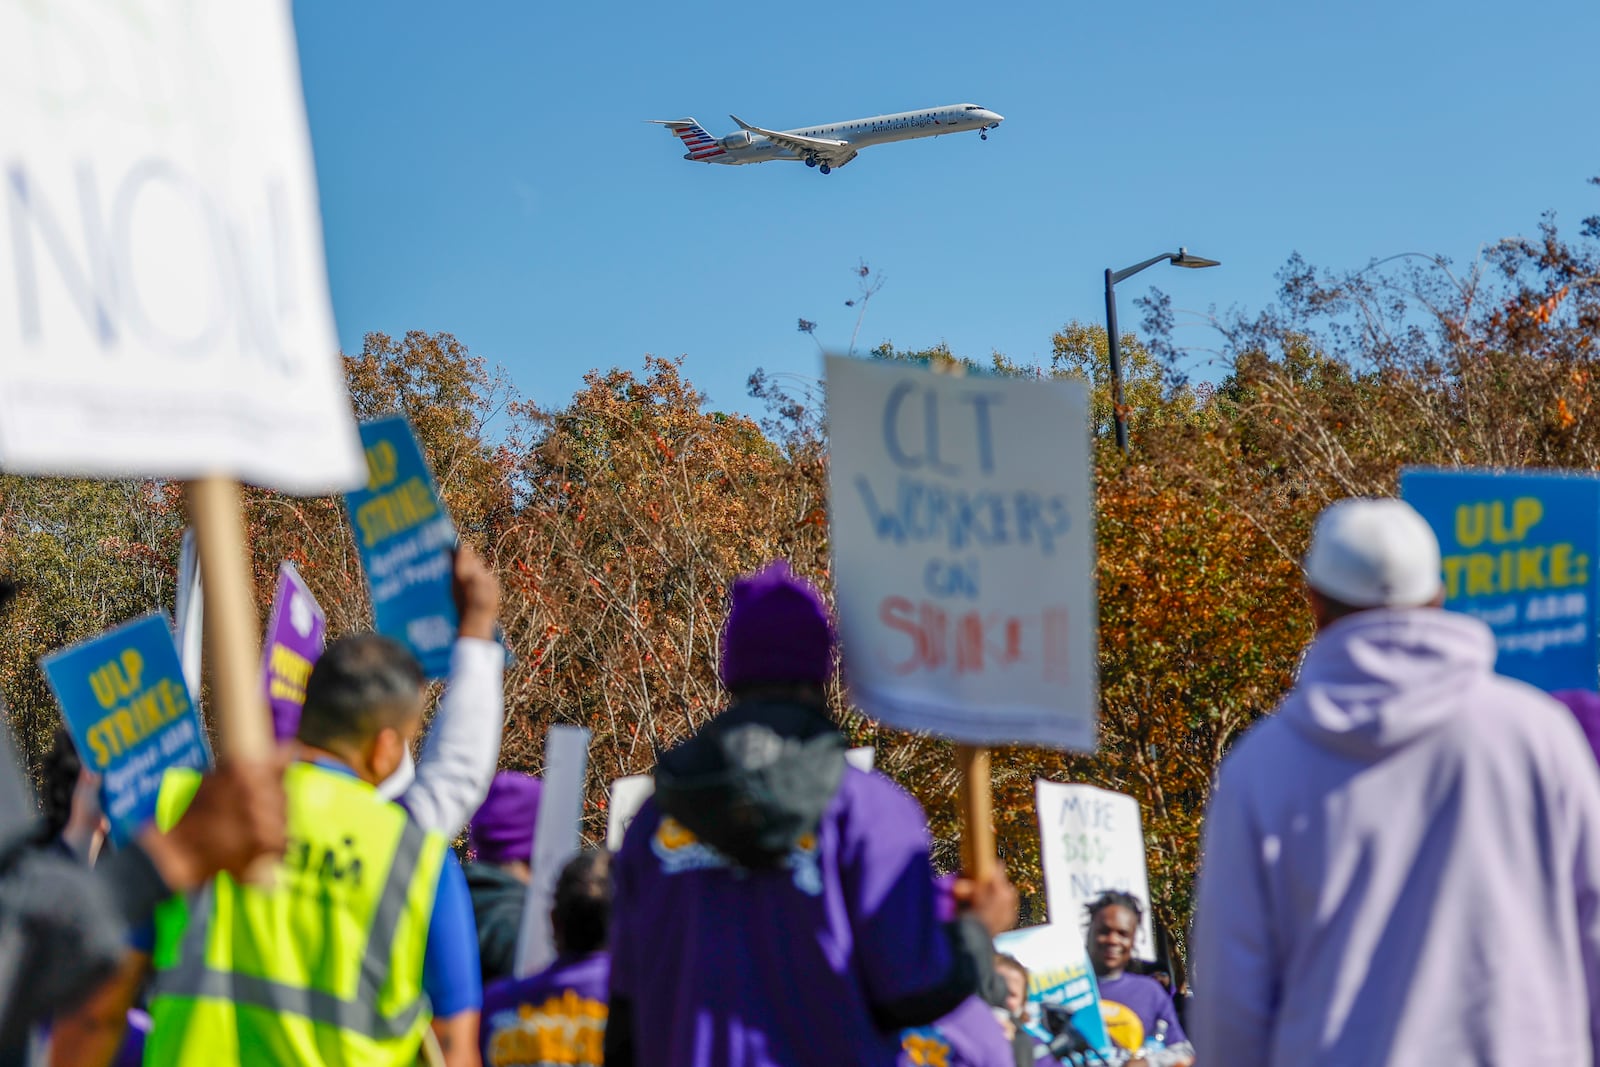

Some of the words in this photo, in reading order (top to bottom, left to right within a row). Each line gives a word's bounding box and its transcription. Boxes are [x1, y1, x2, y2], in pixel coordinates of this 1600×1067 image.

[872, 122, 909, 133] American
[911, 117, 931, 128] Eagle
[882, 379, 1006, 476] CLT
[1455, 496, 1544, 547] ULP
[1441, 542, 1589, 600] TRIKE:
[88, 648, 144, 708] ULP
